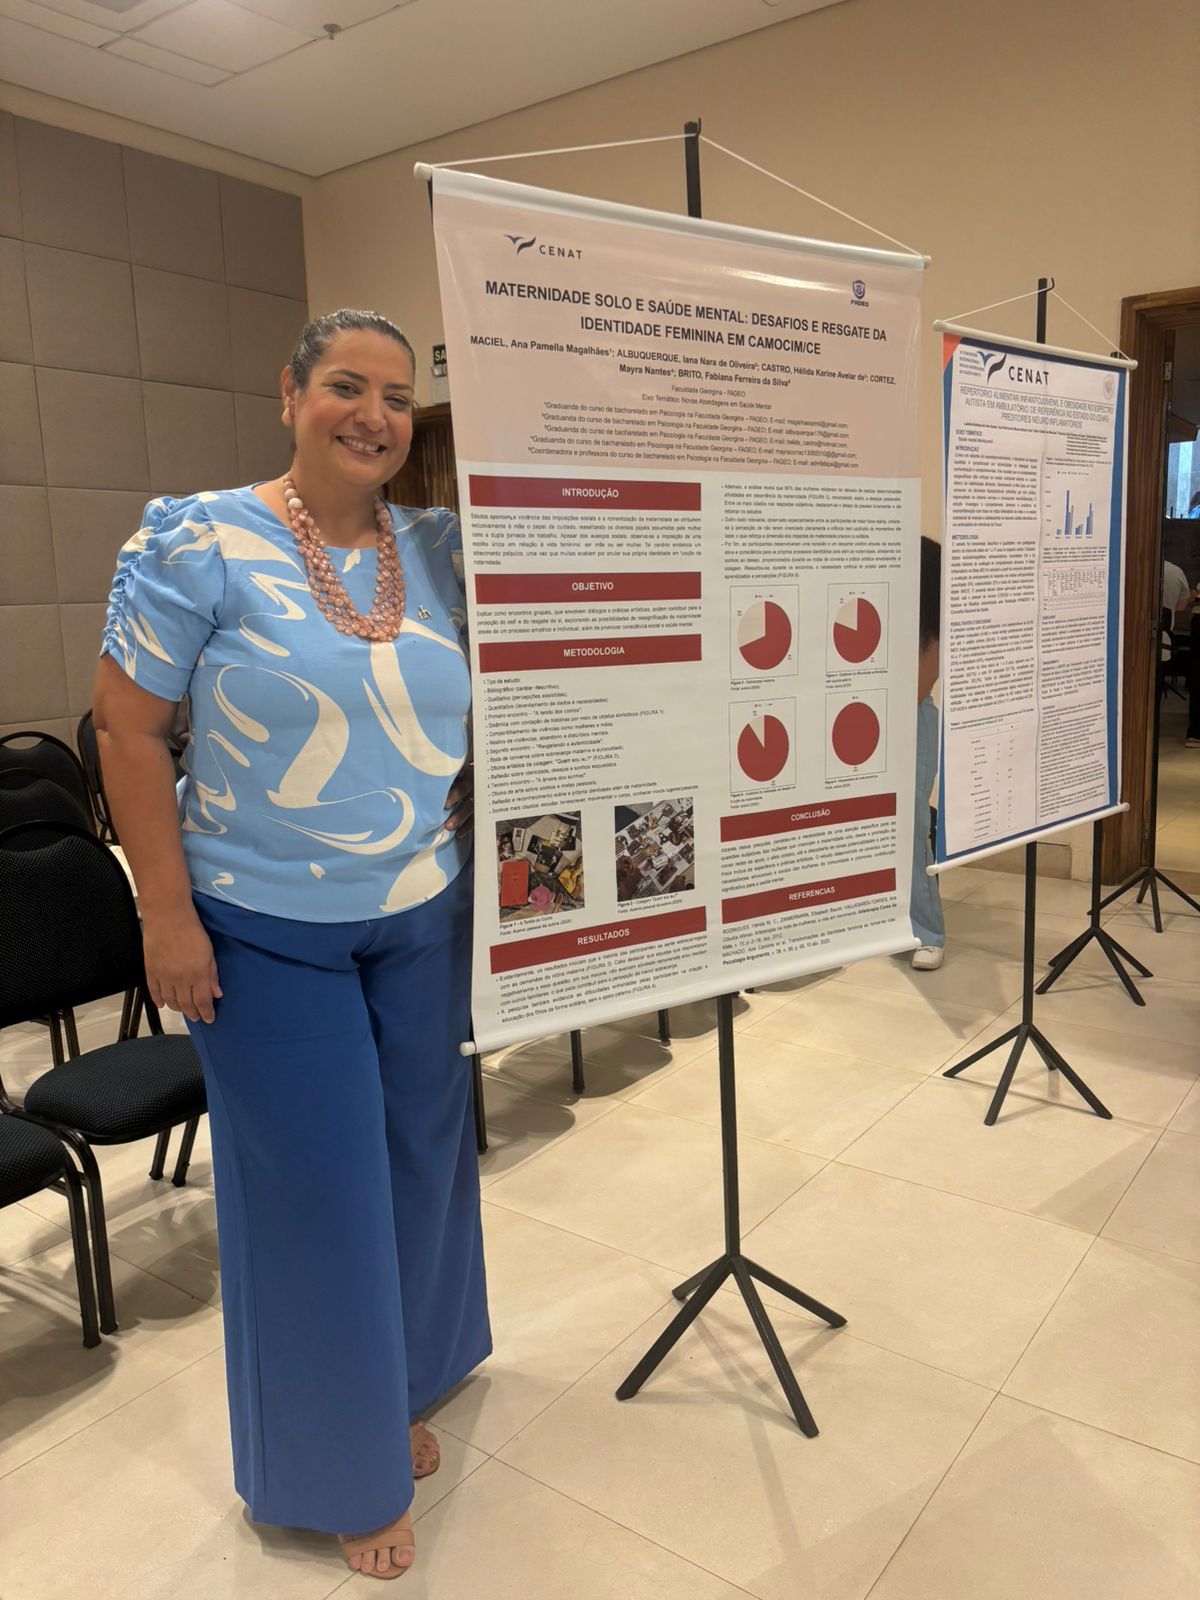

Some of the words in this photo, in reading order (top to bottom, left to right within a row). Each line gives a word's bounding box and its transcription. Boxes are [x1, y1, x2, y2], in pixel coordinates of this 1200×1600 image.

[539, 244, 582, 260] CENAT
[485, 280, 590, 305] MATERNIDADE
[594, 293, 632, 310] SOLO
[635, 299, 644, 311] E
[648, 297, 692, 317] SAÚDE
[695, 306, 747, 324] MENTAL:
[751, 313, 808, 331] DESAFIOS
[811, 321, 818, 332] E
[821, 322, 870, 339] RESGATE
[872, 329, 886, 340] DA
[580, 316, 661, 336] IDENTIDADE
[665, 326, 724, 343] FEMININA
[727, 333, 744, 346] EM
[748, 335, 820, 354] CAMOCIM/CE
[434, 349, 447, 362] SA
[470, 334, 508, 348] MACIEL,
[510, 338, 528, 348] Ana
[815, 369, 836, 378] Karine
[1008, 365, 1048, 386] CENAT
[562, 485, 619, 499] INTRODUÇÃO
[571, 582, 614, 590] OBJETIVO
[563, 646, 624, 657] METODOLOGIA
[790, 806, 830, 821] CONCLUSÃO
[577, 927, 629, 945] RESULTADOS
